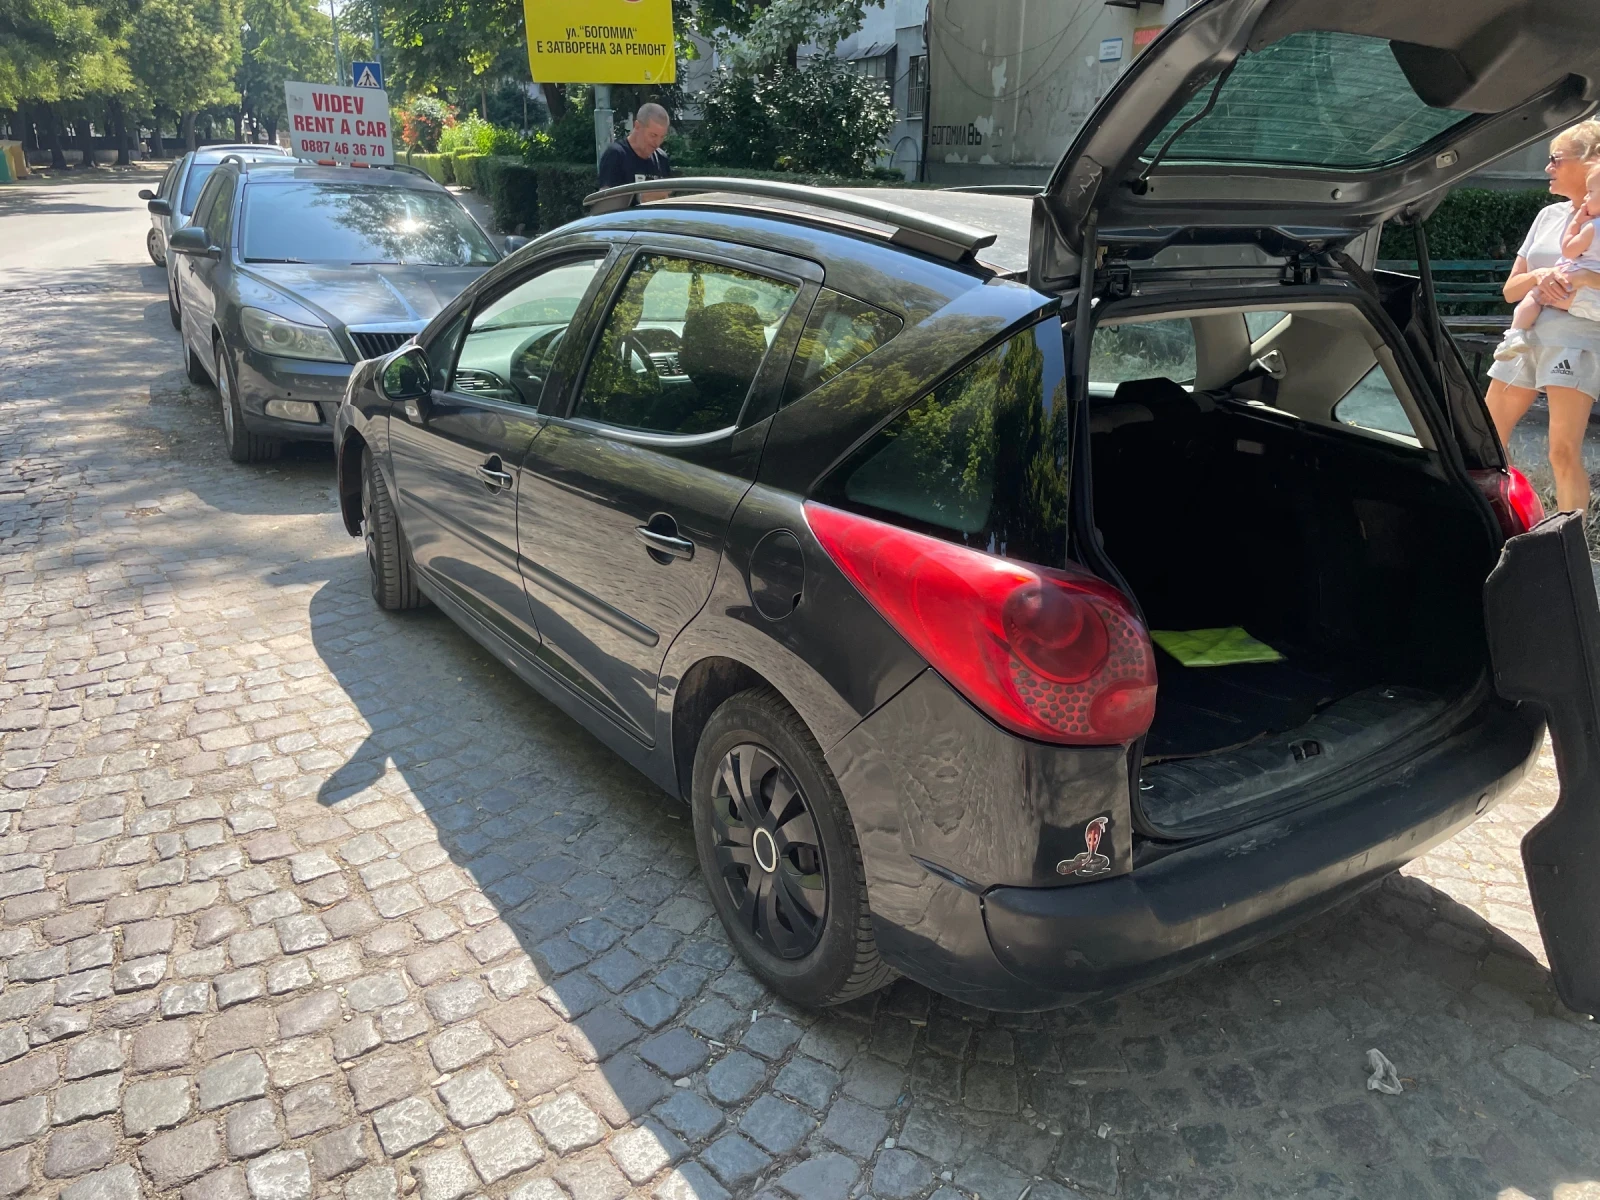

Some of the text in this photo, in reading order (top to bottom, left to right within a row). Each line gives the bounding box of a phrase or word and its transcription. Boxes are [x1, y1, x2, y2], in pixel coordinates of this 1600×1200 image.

[566, 27, 580, 40] ул.
[537, 41, 667, 56] Е ЗАТВОРЕНА ЗА РЕМОНТ
[312, 92, 364, 115] VIDEV
[293, 114, 387, 138] RENT A CAR
[301, 139, 385, 157] 0887 46 36 70
